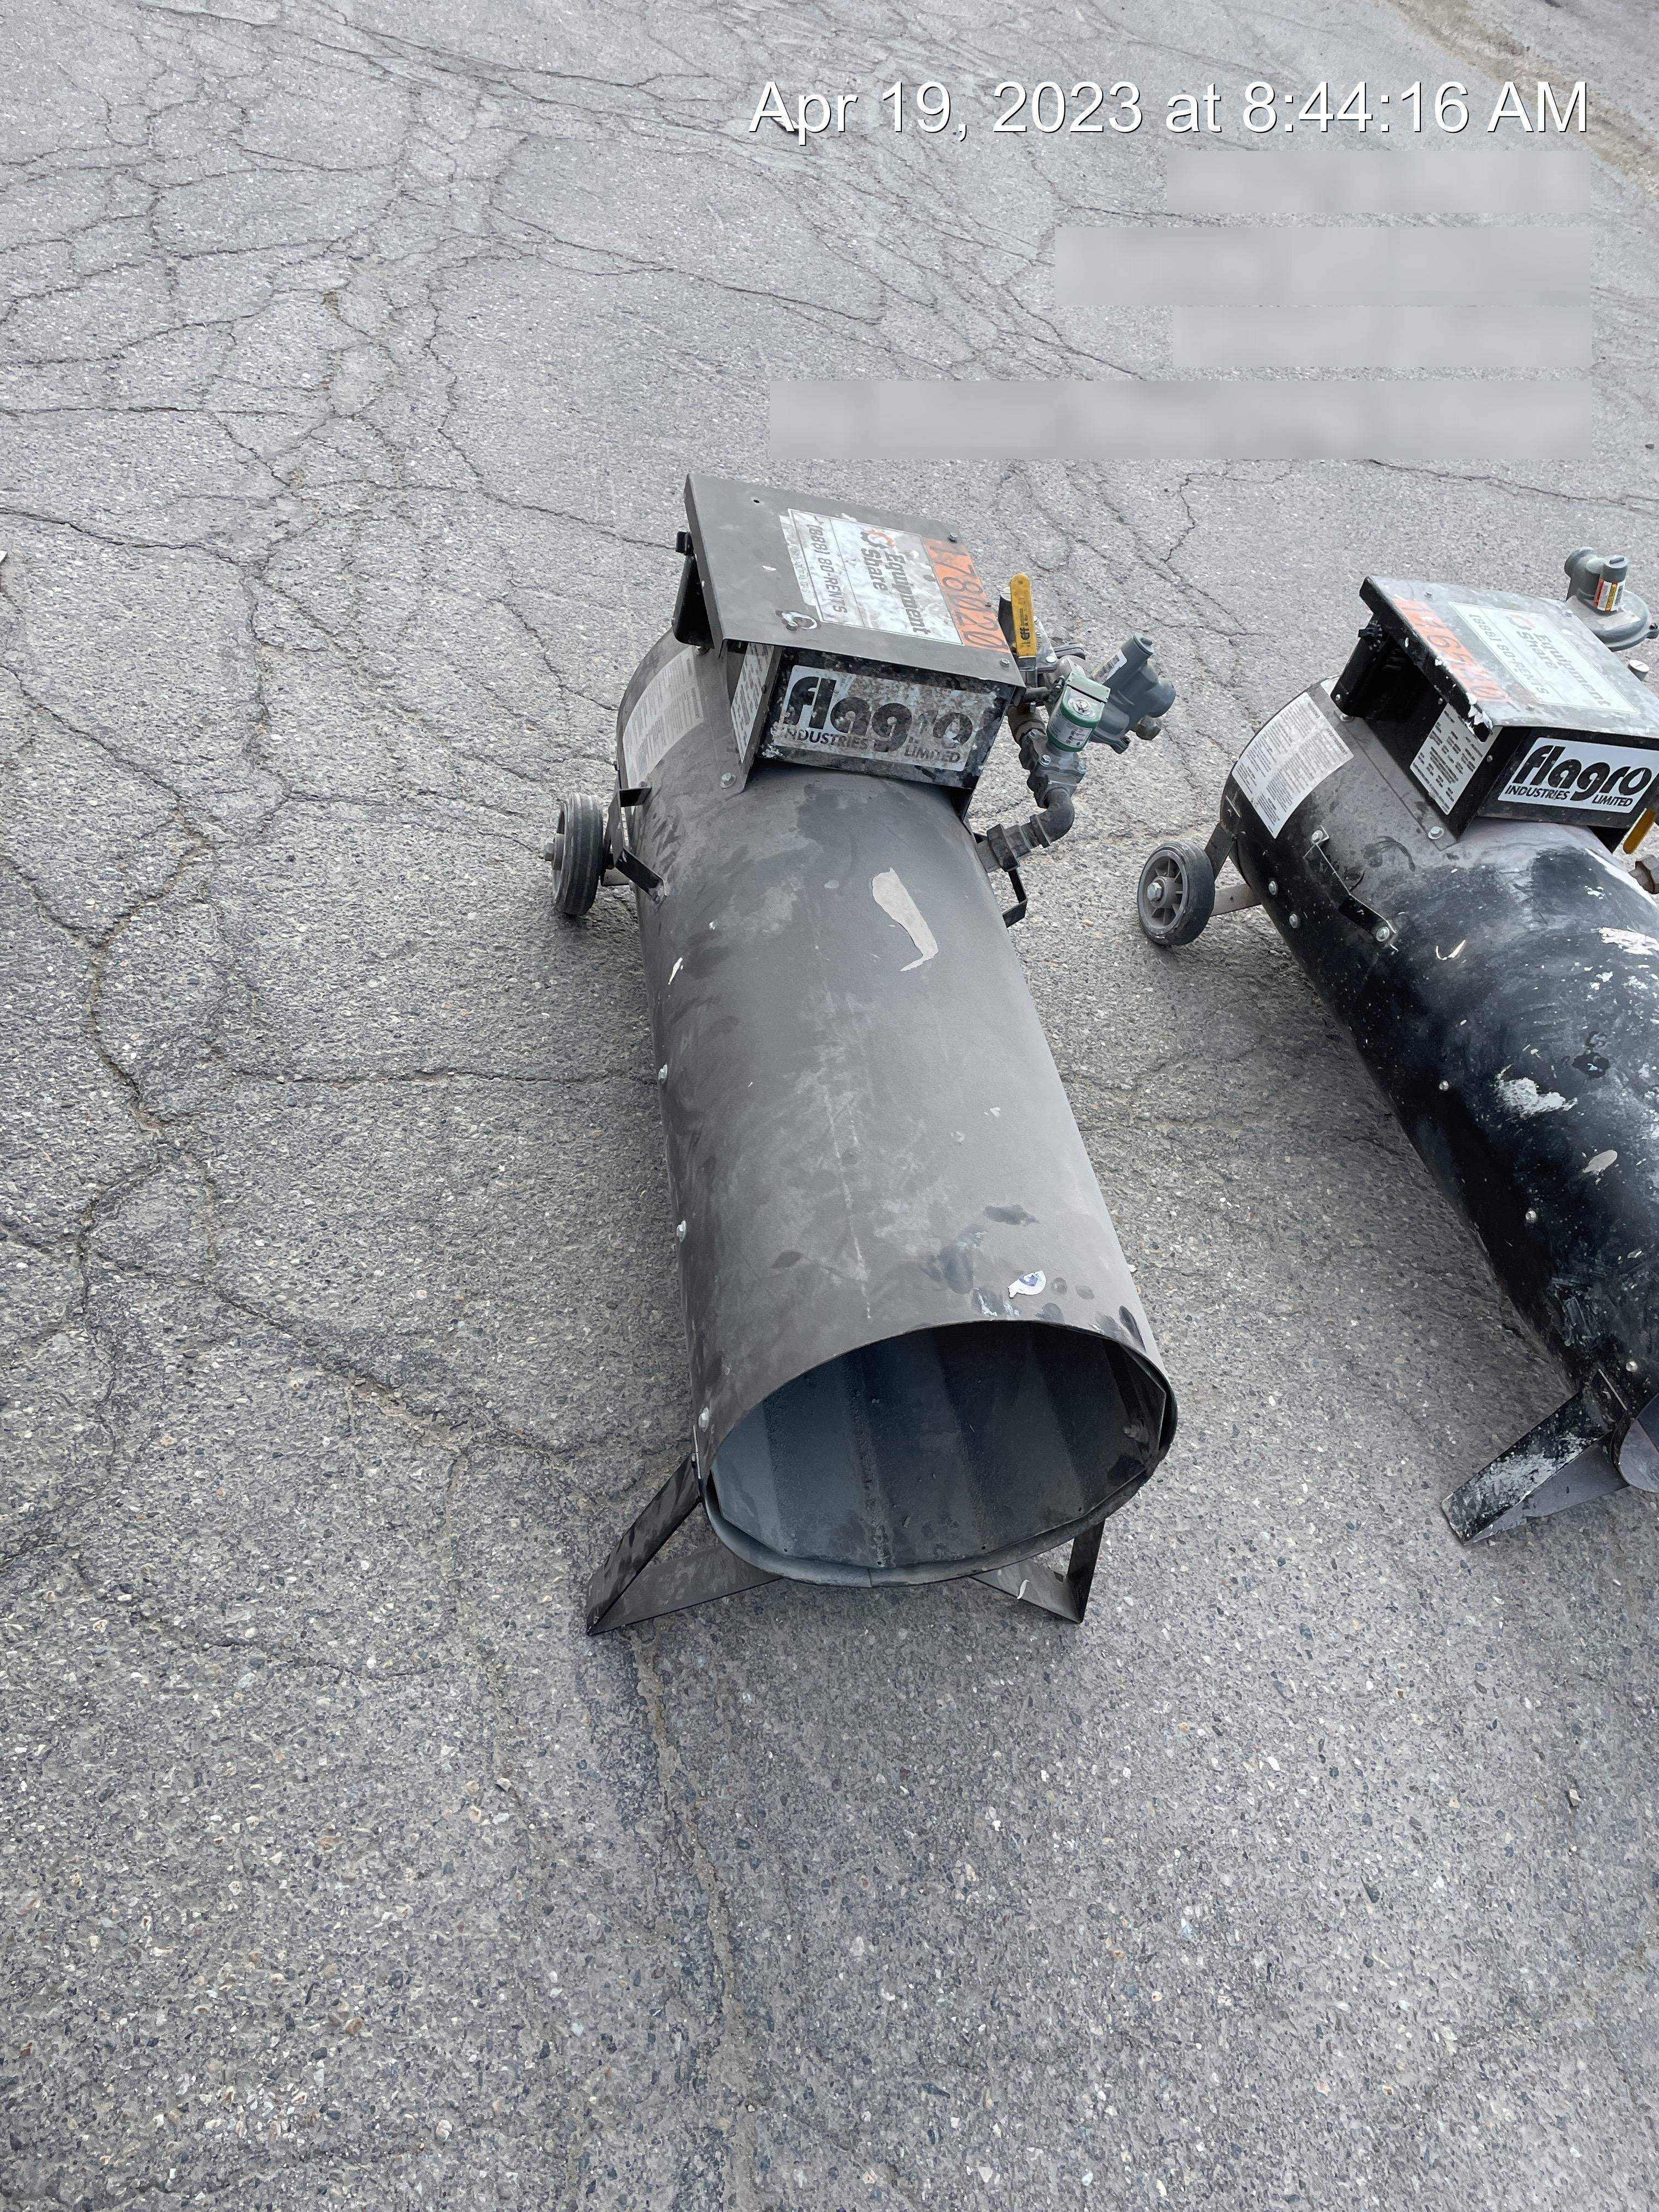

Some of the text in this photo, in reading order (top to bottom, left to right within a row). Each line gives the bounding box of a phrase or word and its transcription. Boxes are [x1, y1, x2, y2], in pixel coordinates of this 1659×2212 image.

[806, 523, 848, 614] (888) 80-RENTS
[861, 548, 888, 592] Share
[884, 552, 932, 635] Equipment
[1516, 630, 1559, 670] Share
[1533, 633, 1612, 707] Equipment
[781, 727, 870, 750] NDUSTRIES
[1504, 785, 1634, 807] INDUSTRIES LIMITED
[1512, 744, 1653, 801] flagro
